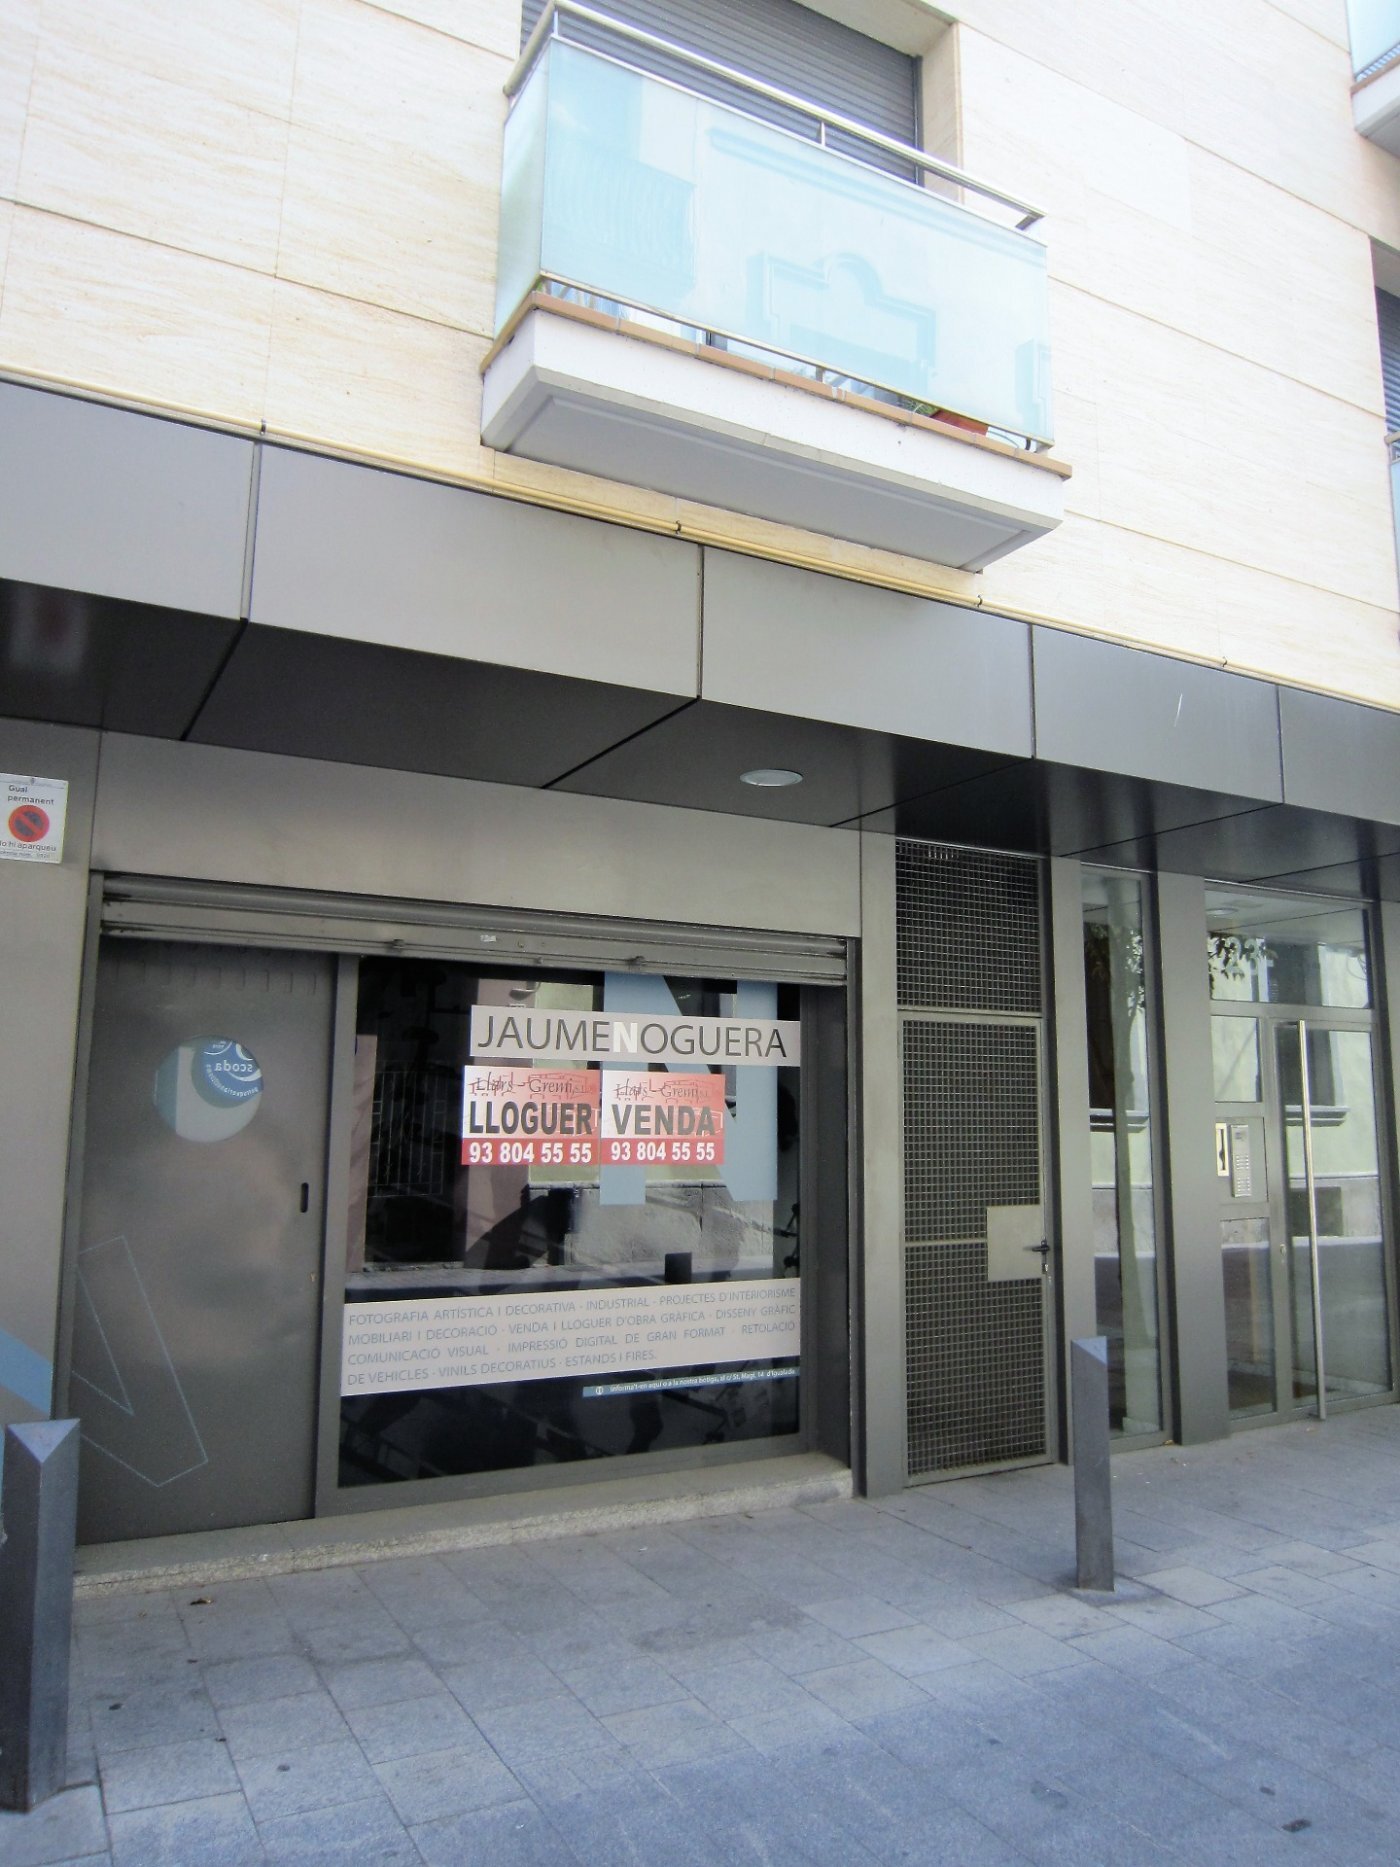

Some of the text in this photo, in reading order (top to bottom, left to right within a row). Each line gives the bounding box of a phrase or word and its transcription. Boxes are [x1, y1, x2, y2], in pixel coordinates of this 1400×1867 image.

[7, 795, 55, 805] permanent
[9, 784, 28, 793] Gual
[17, 843, 57, 852] aparqueu
[469, 1101, 592, 1135] LLOGUER
[612, 1104, 715, 1136] VENDA
[469, 1142, 592, 1164] 93 804 55 55
[611, 1142, 715, 1161] 93 804 55 55
[349, 1310, 429, 1326] FOTOGRAFIA
[506, 1301, 576, 1316] DECORATIVA
[586, 1297, 650, 1310] INDUSTRIAL
[660, 1292, 716, 1306] PROJECTES
[720, 1287, 796, 1302] D'INTERIORISME
[348, 1330, 412, 1346] MOBILIARI
[508, 1321, 548, 1334] VENDA
[562, 1317, 612, 1330] LLOGUER
[616, 1314, 657, 1327] D'OBRA
[716, 1307, 758, 1320] DISSENY
[760, 1304, 796, 1316] GRÀFIC
[448, 1344, 489, 1358] VISUAL
[576, 1335, 618, 1348] DIGITAL
[625, 1333, 640, 1344] DE
[647, 1330, 677, 1342] GRAN
[684, 1326, 726, 1339] FORMAT
[348, 1374, 366, 1386] DE
[368, 1368, 430, 1383] VEHICLES
[439, 1364, 478, 1377] VINILS
[480, 1358, 556, 1374] DECORATIUS
[566, 1352, 617, 1368] ESTANDS
[626, 1349, 657, 1361] FIRES.
